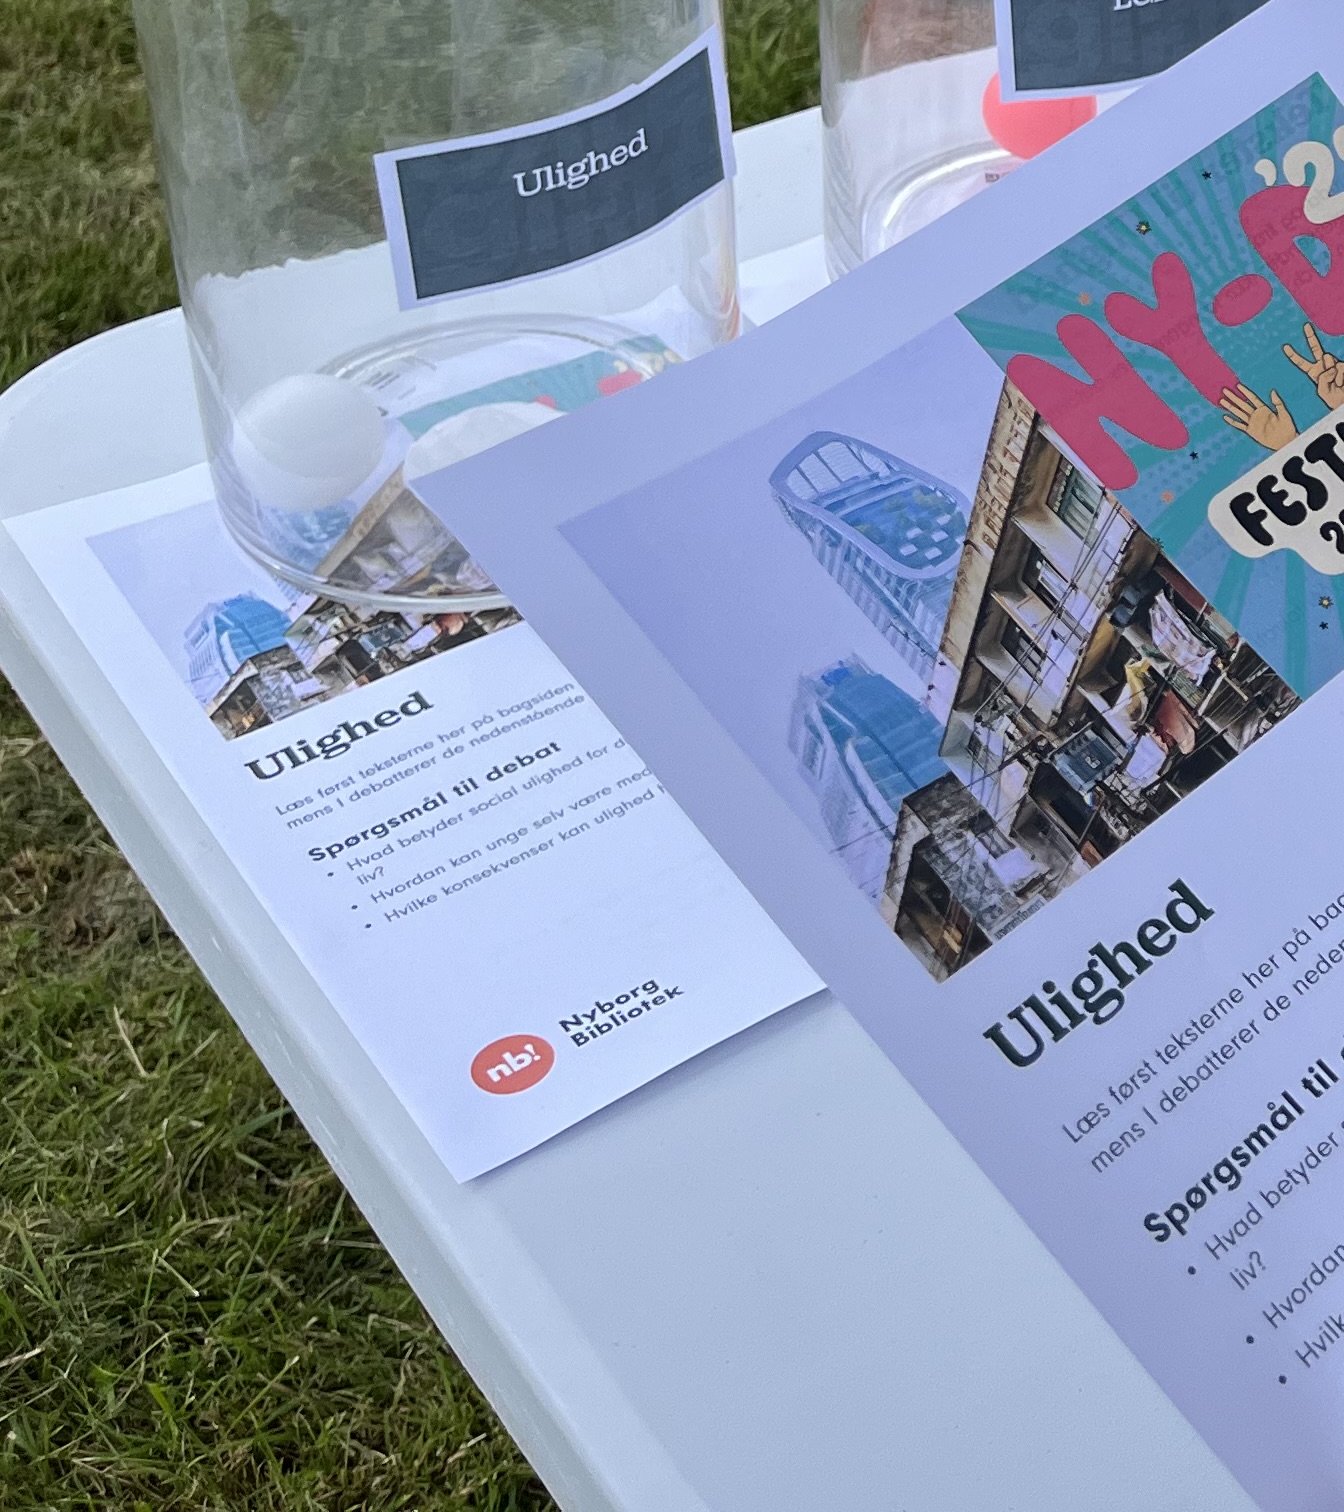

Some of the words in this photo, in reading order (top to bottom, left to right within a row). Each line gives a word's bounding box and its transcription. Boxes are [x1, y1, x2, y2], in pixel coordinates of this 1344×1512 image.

[513, 127, 648, 199] Ulighed
[244, 690, 435, 780] Ulighed
[274, 795, 313, 815] Læs
[316, 775, 355, 798] først
[358, 741, 433, 779] teksterne
[436, 725, 465, 743] her
[470, 714, 494, 731] på
[496, 681, 576, 717] bagsiden
[308, 791, 447, 861] Spørgsmål
[452, 777, 479, 796] til
[486, 742, 560, 781] debat
[346, 843, 394, 871] Hvad
[396, 812, 463, 848] betyder
[468, 785, 518, 816] social
[522, 755, 583, 790] ulighed
[585, 745, 607, 760] for
[370, 865, 446, 903] Hvordan
[448, 849, 482, 867] kan
[485, 827, 528, 850] unge
[532, 808, 564, 829] selv
[567, 787, 611, 810] være
[383, 894, 437, 922] Hvilke
[440, 838, 554, 895] konsekvenser
[557, 822, 590, 841] kan
[594, 787, 655, 824] ulighed
[356, 865, 384, 885] liv?
[559, 978, 660, 1034] Nyborg
[570, 982, 685, 1048] Bibliotek
[983, 878, 1215, 1068] Ulighed
[485, 1042, 541, 1085] nb!
[1062, 1102, 1110, 1142] Læs
[1108, 1059, 1157, 1104] først
[1154, 988, 1243, 1064] teksterne
[1241, 954, 1279, 989] her
[1281, 927, 1311, 961] på
[1091, 1122, 1145, 1172] mens
[1159, 1019, 1259, 1112] debatterer
[1263, 995, 1290, 1021] de
[1143, 1090, 1304, 1242] Spørgsmål
[1300, 1058, 1339, 1098] til
[1204, 1201, 1262, 1260] Hvad
[1259, 1132, 1338, 1208] betyder
[1229, 1250, 1266, 1290] liv?
